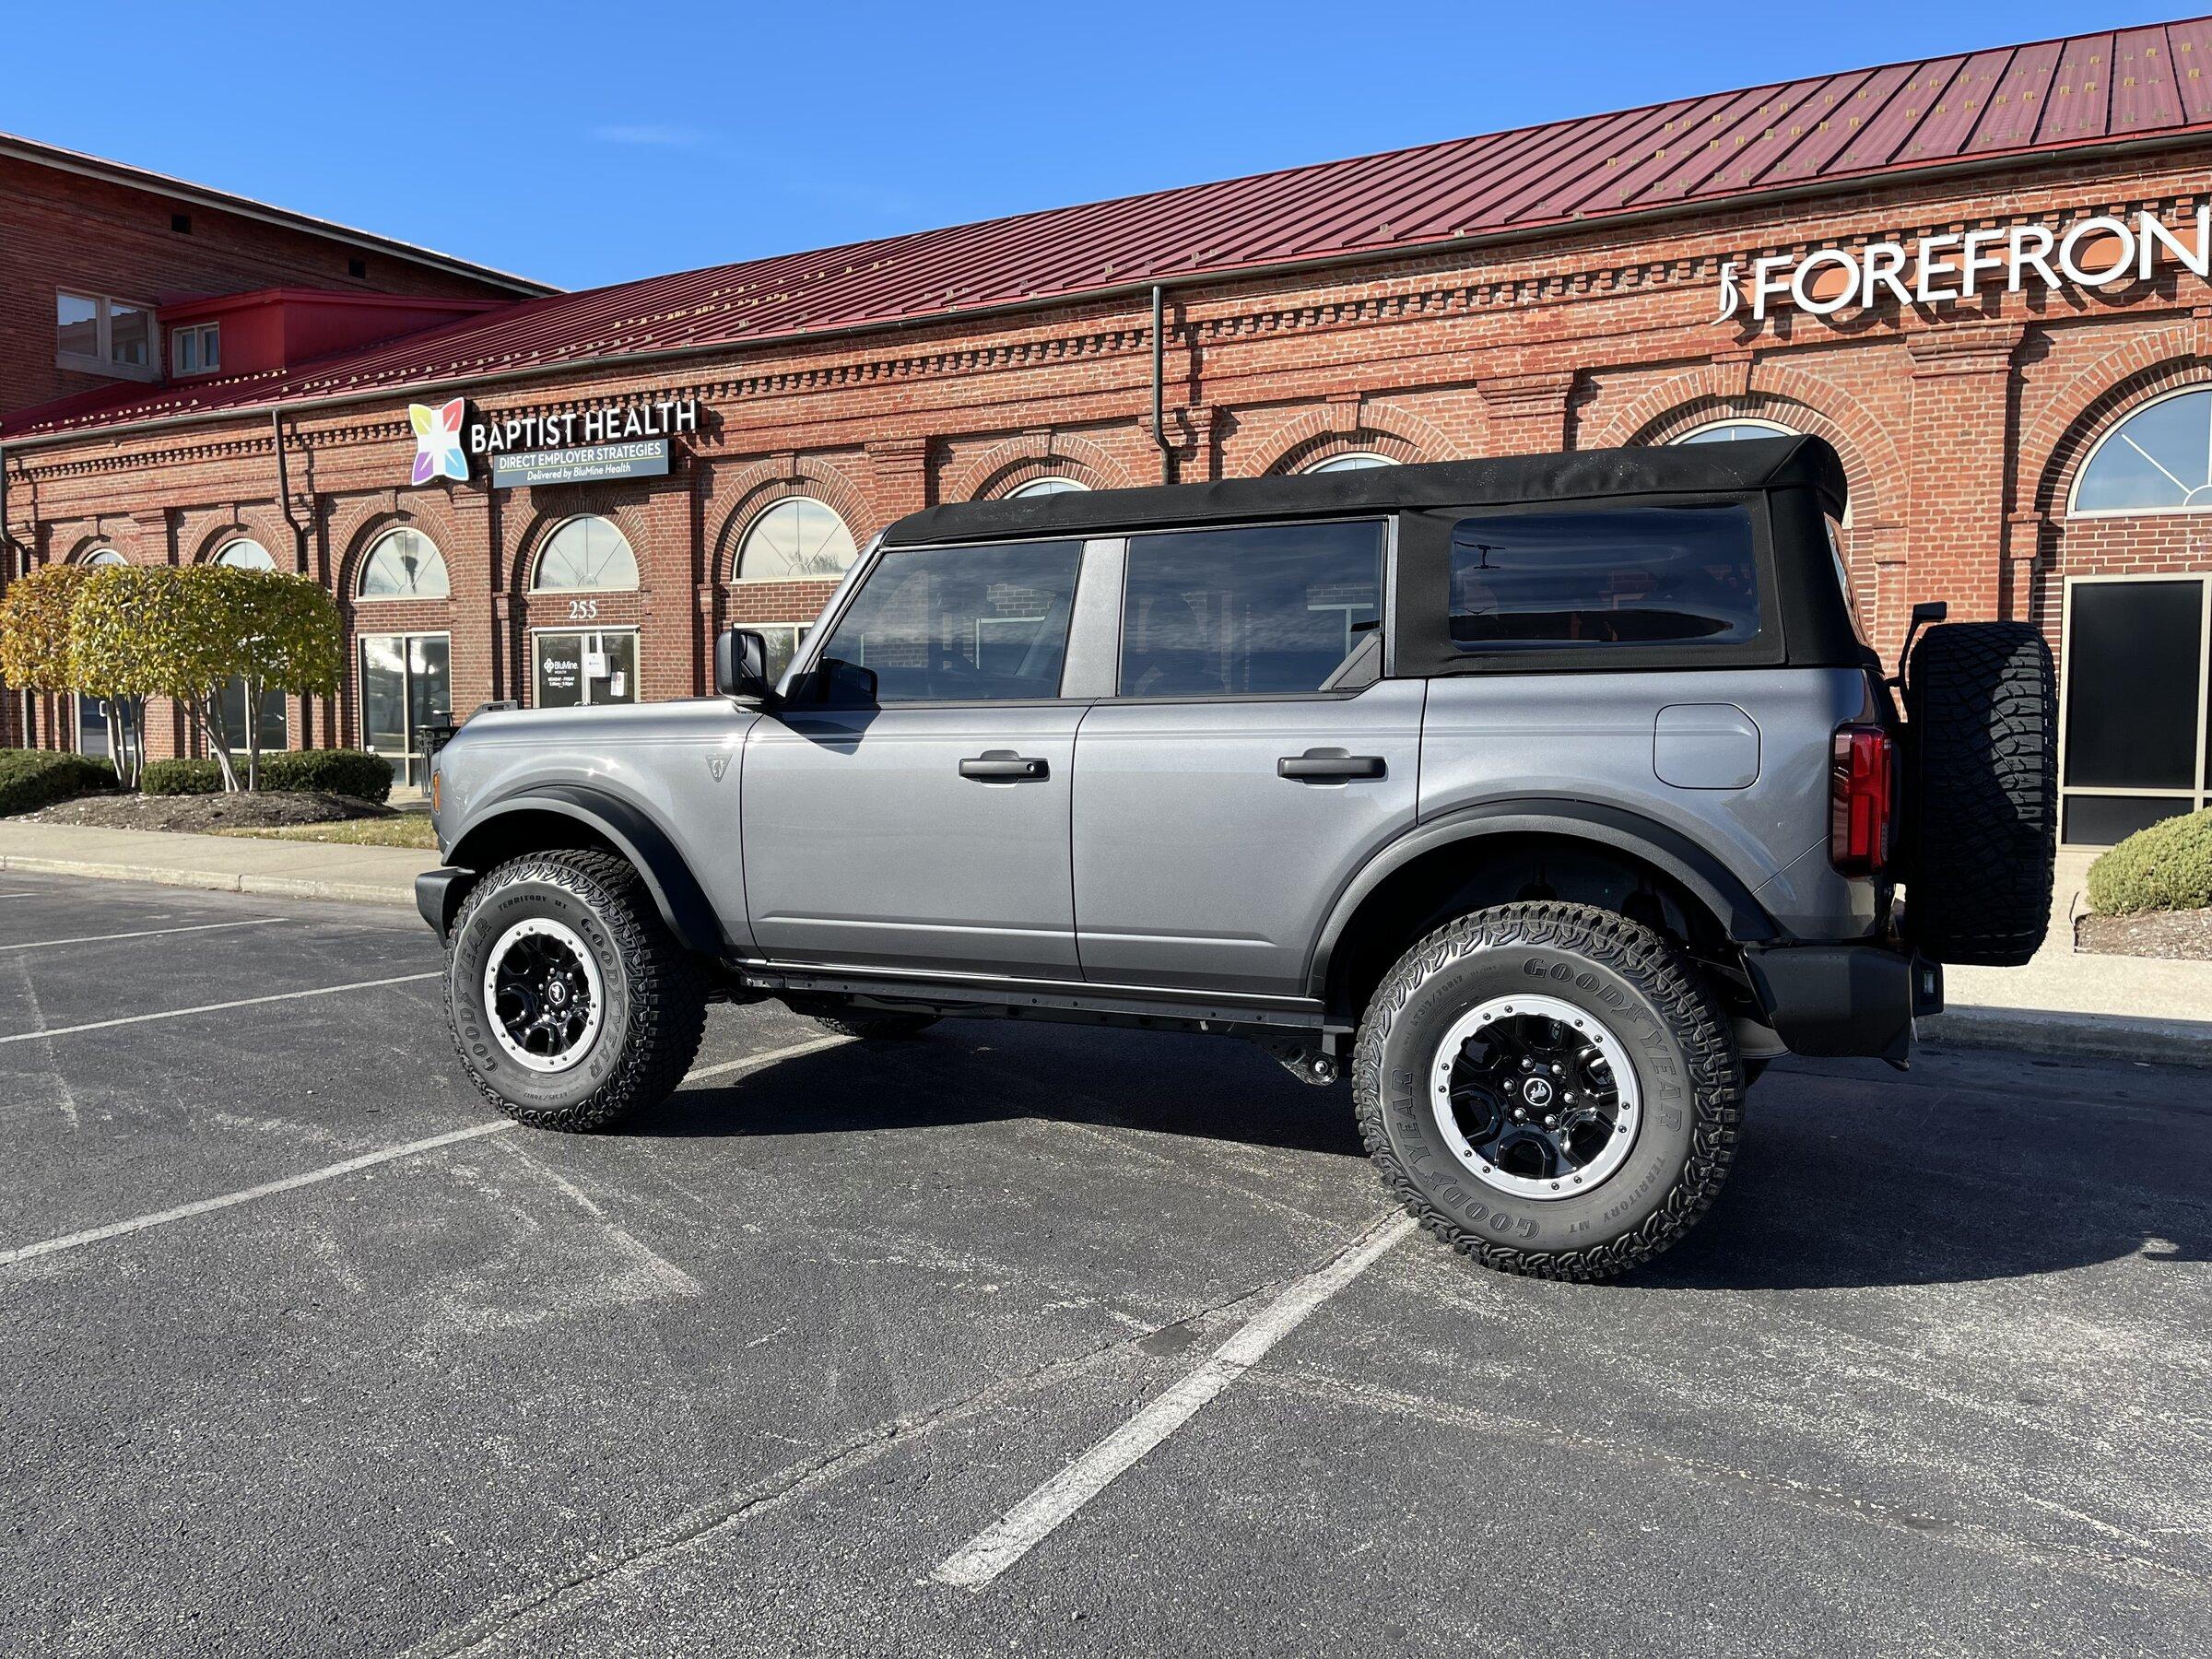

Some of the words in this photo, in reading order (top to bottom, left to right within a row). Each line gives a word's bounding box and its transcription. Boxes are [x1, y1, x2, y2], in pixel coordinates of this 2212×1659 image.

[1753, 205, 2210, 320] FOREFRON
[471, 413, 576, 453] BAPTIST
[585, 399, 696, 441] HEALTH
[499, 454, 536, 469] DIRECT
[538, 449, 594, 466] EMPLOYER
[597, 442, 662, 461] STRATEGIES
[527, 470, 561, 480] Delivered
[563, 468, 571, 479] by
[573, 465, 604, 477] BluMine
[606, 463, 631, 475] Health
[569, 600, 598, 619] 255
[498, 895, 547, 912] TERRITORY
[453, 917, 499, 1073] GOODYEAR
[581, 917, 626, 1080] GOODYEAR
[1523, 957, 1683, 1133] GOODYEAR
[1391, 1068, 1540, 1241] GOODYEAR
[1604, 1156, 1665, 1223] TERRITORY
